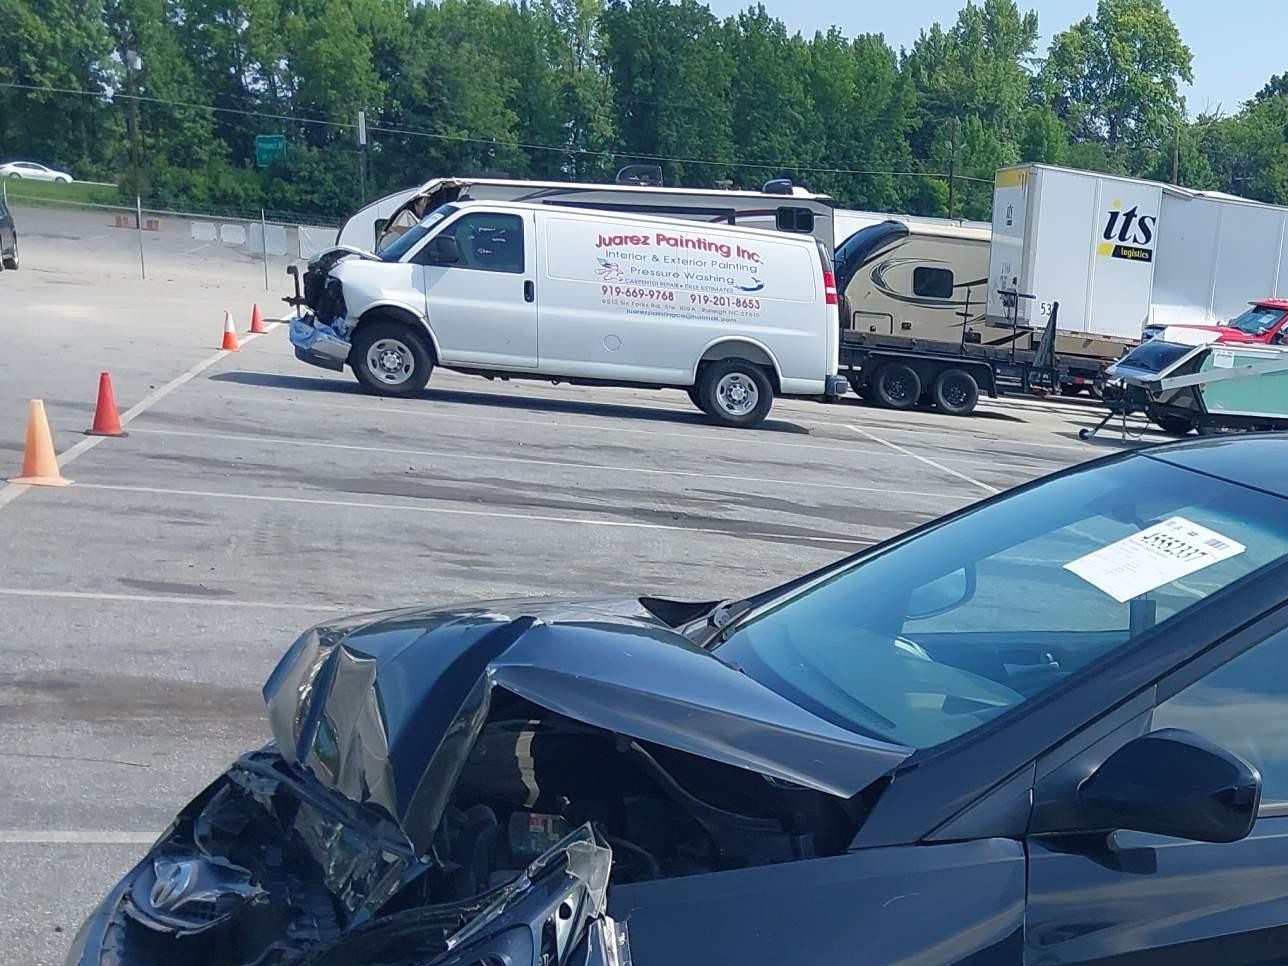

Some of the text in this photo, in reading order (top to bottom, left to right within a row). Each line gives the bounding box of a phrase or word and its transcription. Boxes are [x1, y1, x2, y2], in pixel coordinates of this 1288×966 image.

[1103, 200, 1156, 245] its
[595, 233, 764, 265] Juarez Painting Inc.
[1120, 247, 1149, 259] logistics
[605, 250, 758, 274] Interior & Exterior Painting
[630, 267, 735, 285] Pressure Washing
[602, 285, 760, 310] 919-669-9768 919-201-8653
